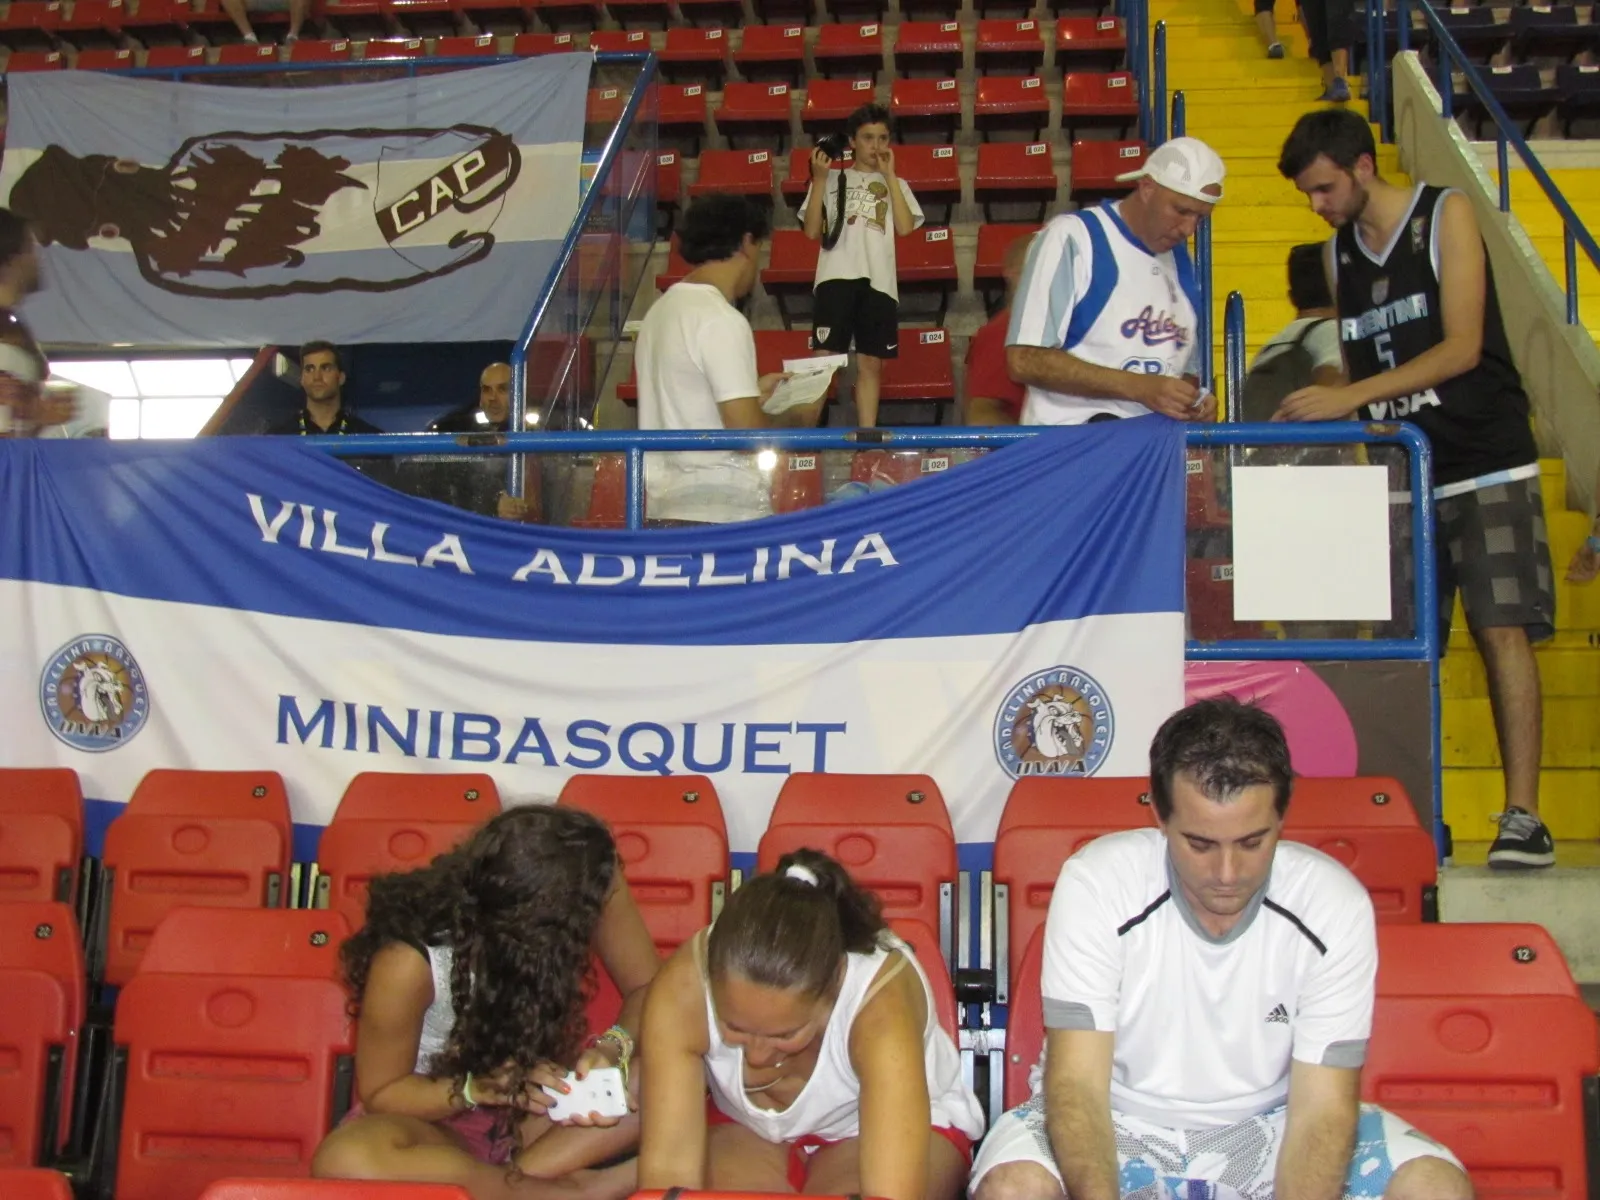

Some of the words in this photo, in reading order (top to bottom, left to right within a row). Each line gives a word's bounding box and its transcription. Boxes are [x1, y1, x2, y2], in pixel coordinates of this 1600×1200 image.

[391, 150, 485, 234] CAP
[933, 231, 946, 239] 024
[929, 333, 942, 341] 024
[1374, 332, 1396, 371] 5
[1368, 388, 1441, 420] VISA
[931, 460, 946, 469] 024
[246, 493, 475, 575] VILLA
[511, 532, 900, 588] ADELINA
[1002, 678, 1045, 750] ADELINA
[1058, 672, 1107, 747] BASQUET
[276, 694, 847, 776] MINIBASQUET
